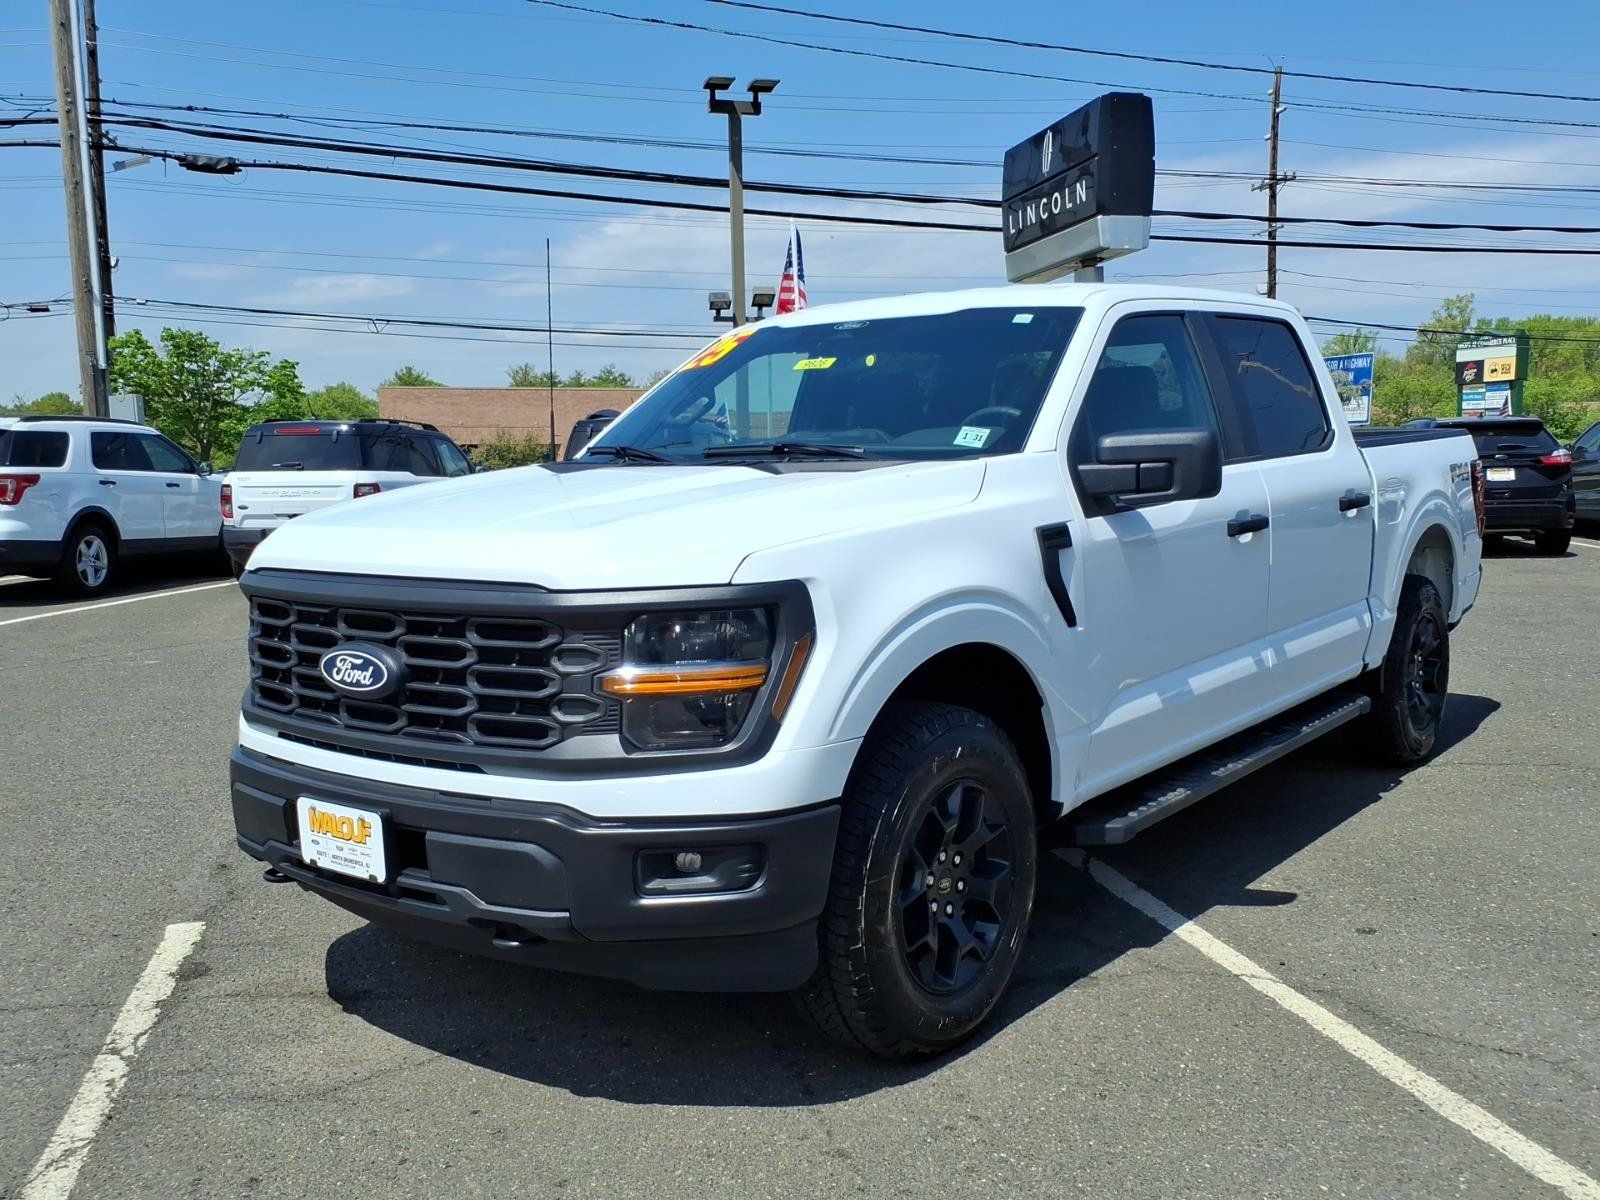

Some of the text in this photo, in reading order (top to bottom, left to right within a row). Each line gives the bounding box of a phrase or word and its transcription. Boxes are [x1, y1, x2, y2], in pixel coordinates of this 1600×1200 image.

[1009, 180, 1086, 234] LINCOLN
[332, 655, 374, 685] Ford
[308, 806, 372, 846] MALOUF
